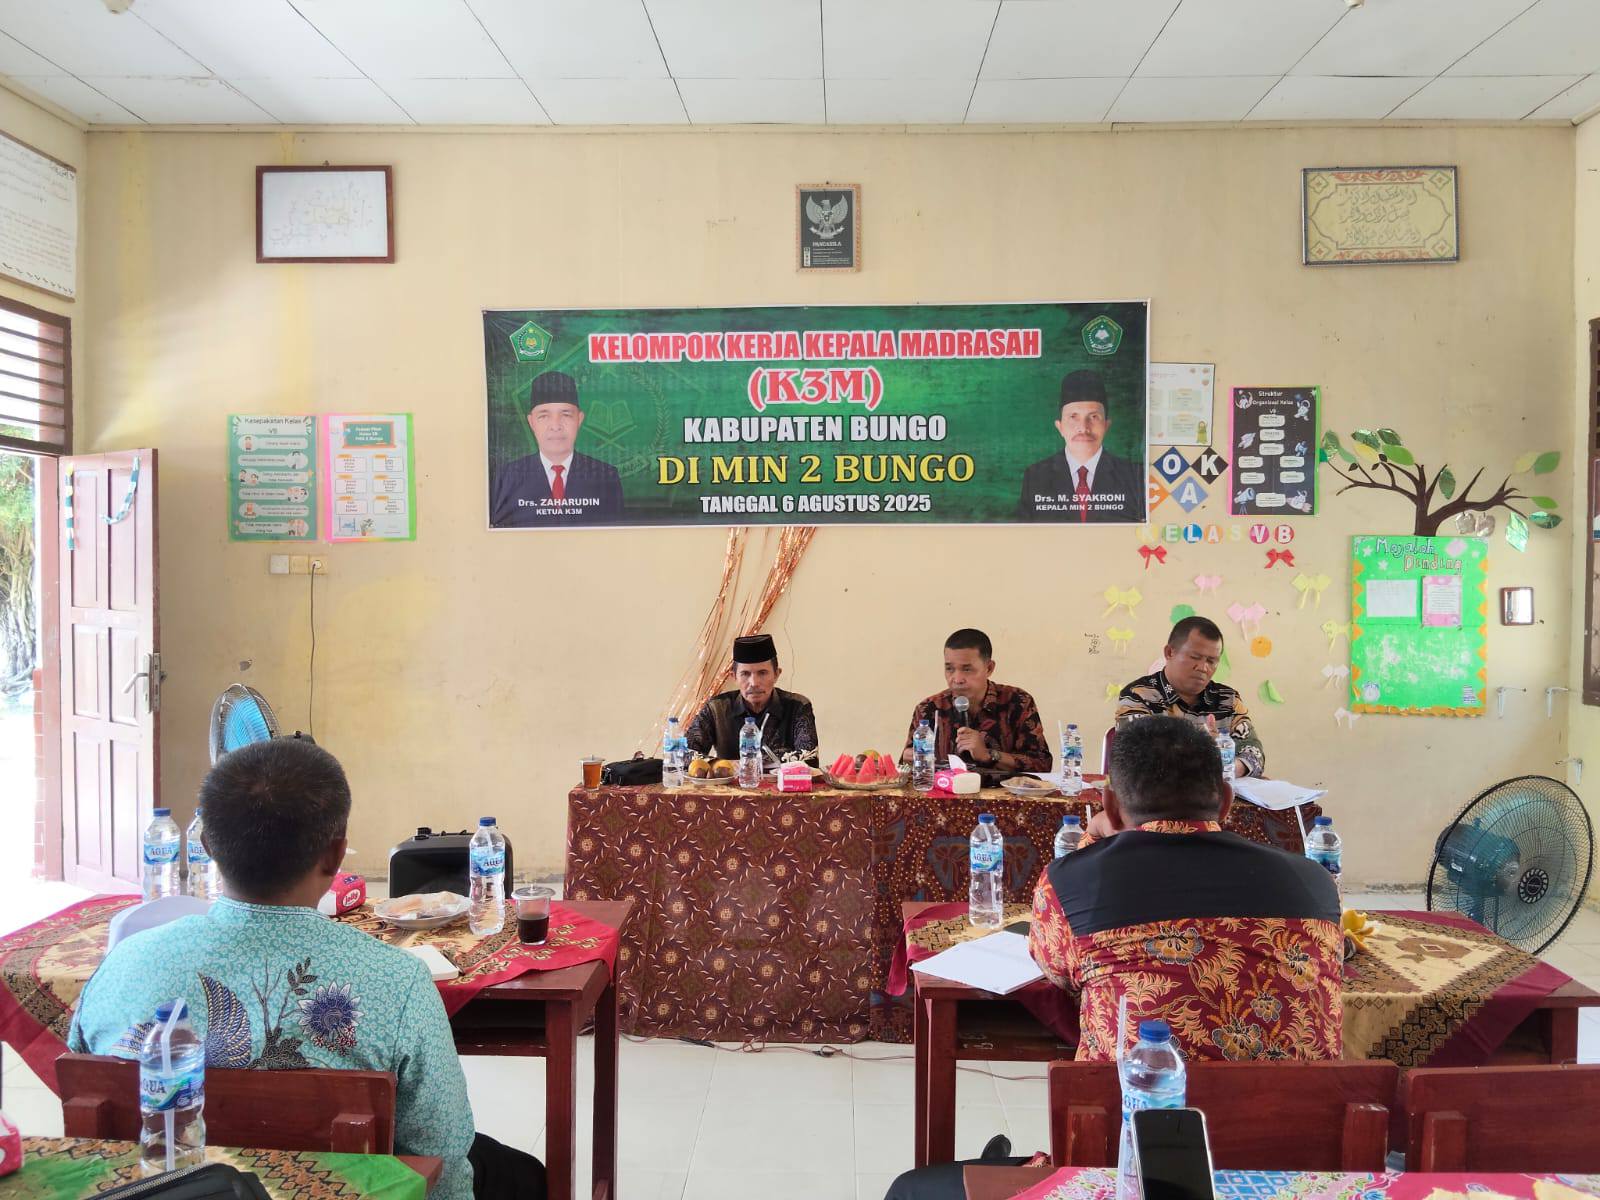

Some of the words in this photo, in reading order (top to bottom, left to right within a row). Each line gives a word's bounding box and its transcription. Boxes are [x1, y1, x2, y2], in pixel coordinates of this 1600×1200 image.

[589, 332, 722, 362] KELOMPOK
[725, 331, 801, 361] KERJA
[803, 330, 897, 360] KEPALA
[899, 328, 1042, 359] MADRASAH
[748, 366, 884, 412] (K3M)
[683, 416, 843, 443] KABUPATEN
[849, 415, 947, 441] BUNGO
[657, 456, 701, 484] DI
[711, 455, 788, 484] MIN
[799, 455, 823, 483] 2
[834, 454, 975, 483] BUNGO
[518, 499, 537, 507] Drs.
[540, 498, 600, 506] ZAHARUDIN
[700, 496, 778, 513] TANGGAL
[782, 495, 794, 512] 6
[798, 495, 880, 512] AGUSTUS
[884, 494, 931, 512] 2025
[1034, 494, 1054, 502] Drs.
[1057, 494, 1070, 502] M.
[1072, 494, 1125, 502] SYAKRONI
[1094, 503, 1124, 511] BUNGO
